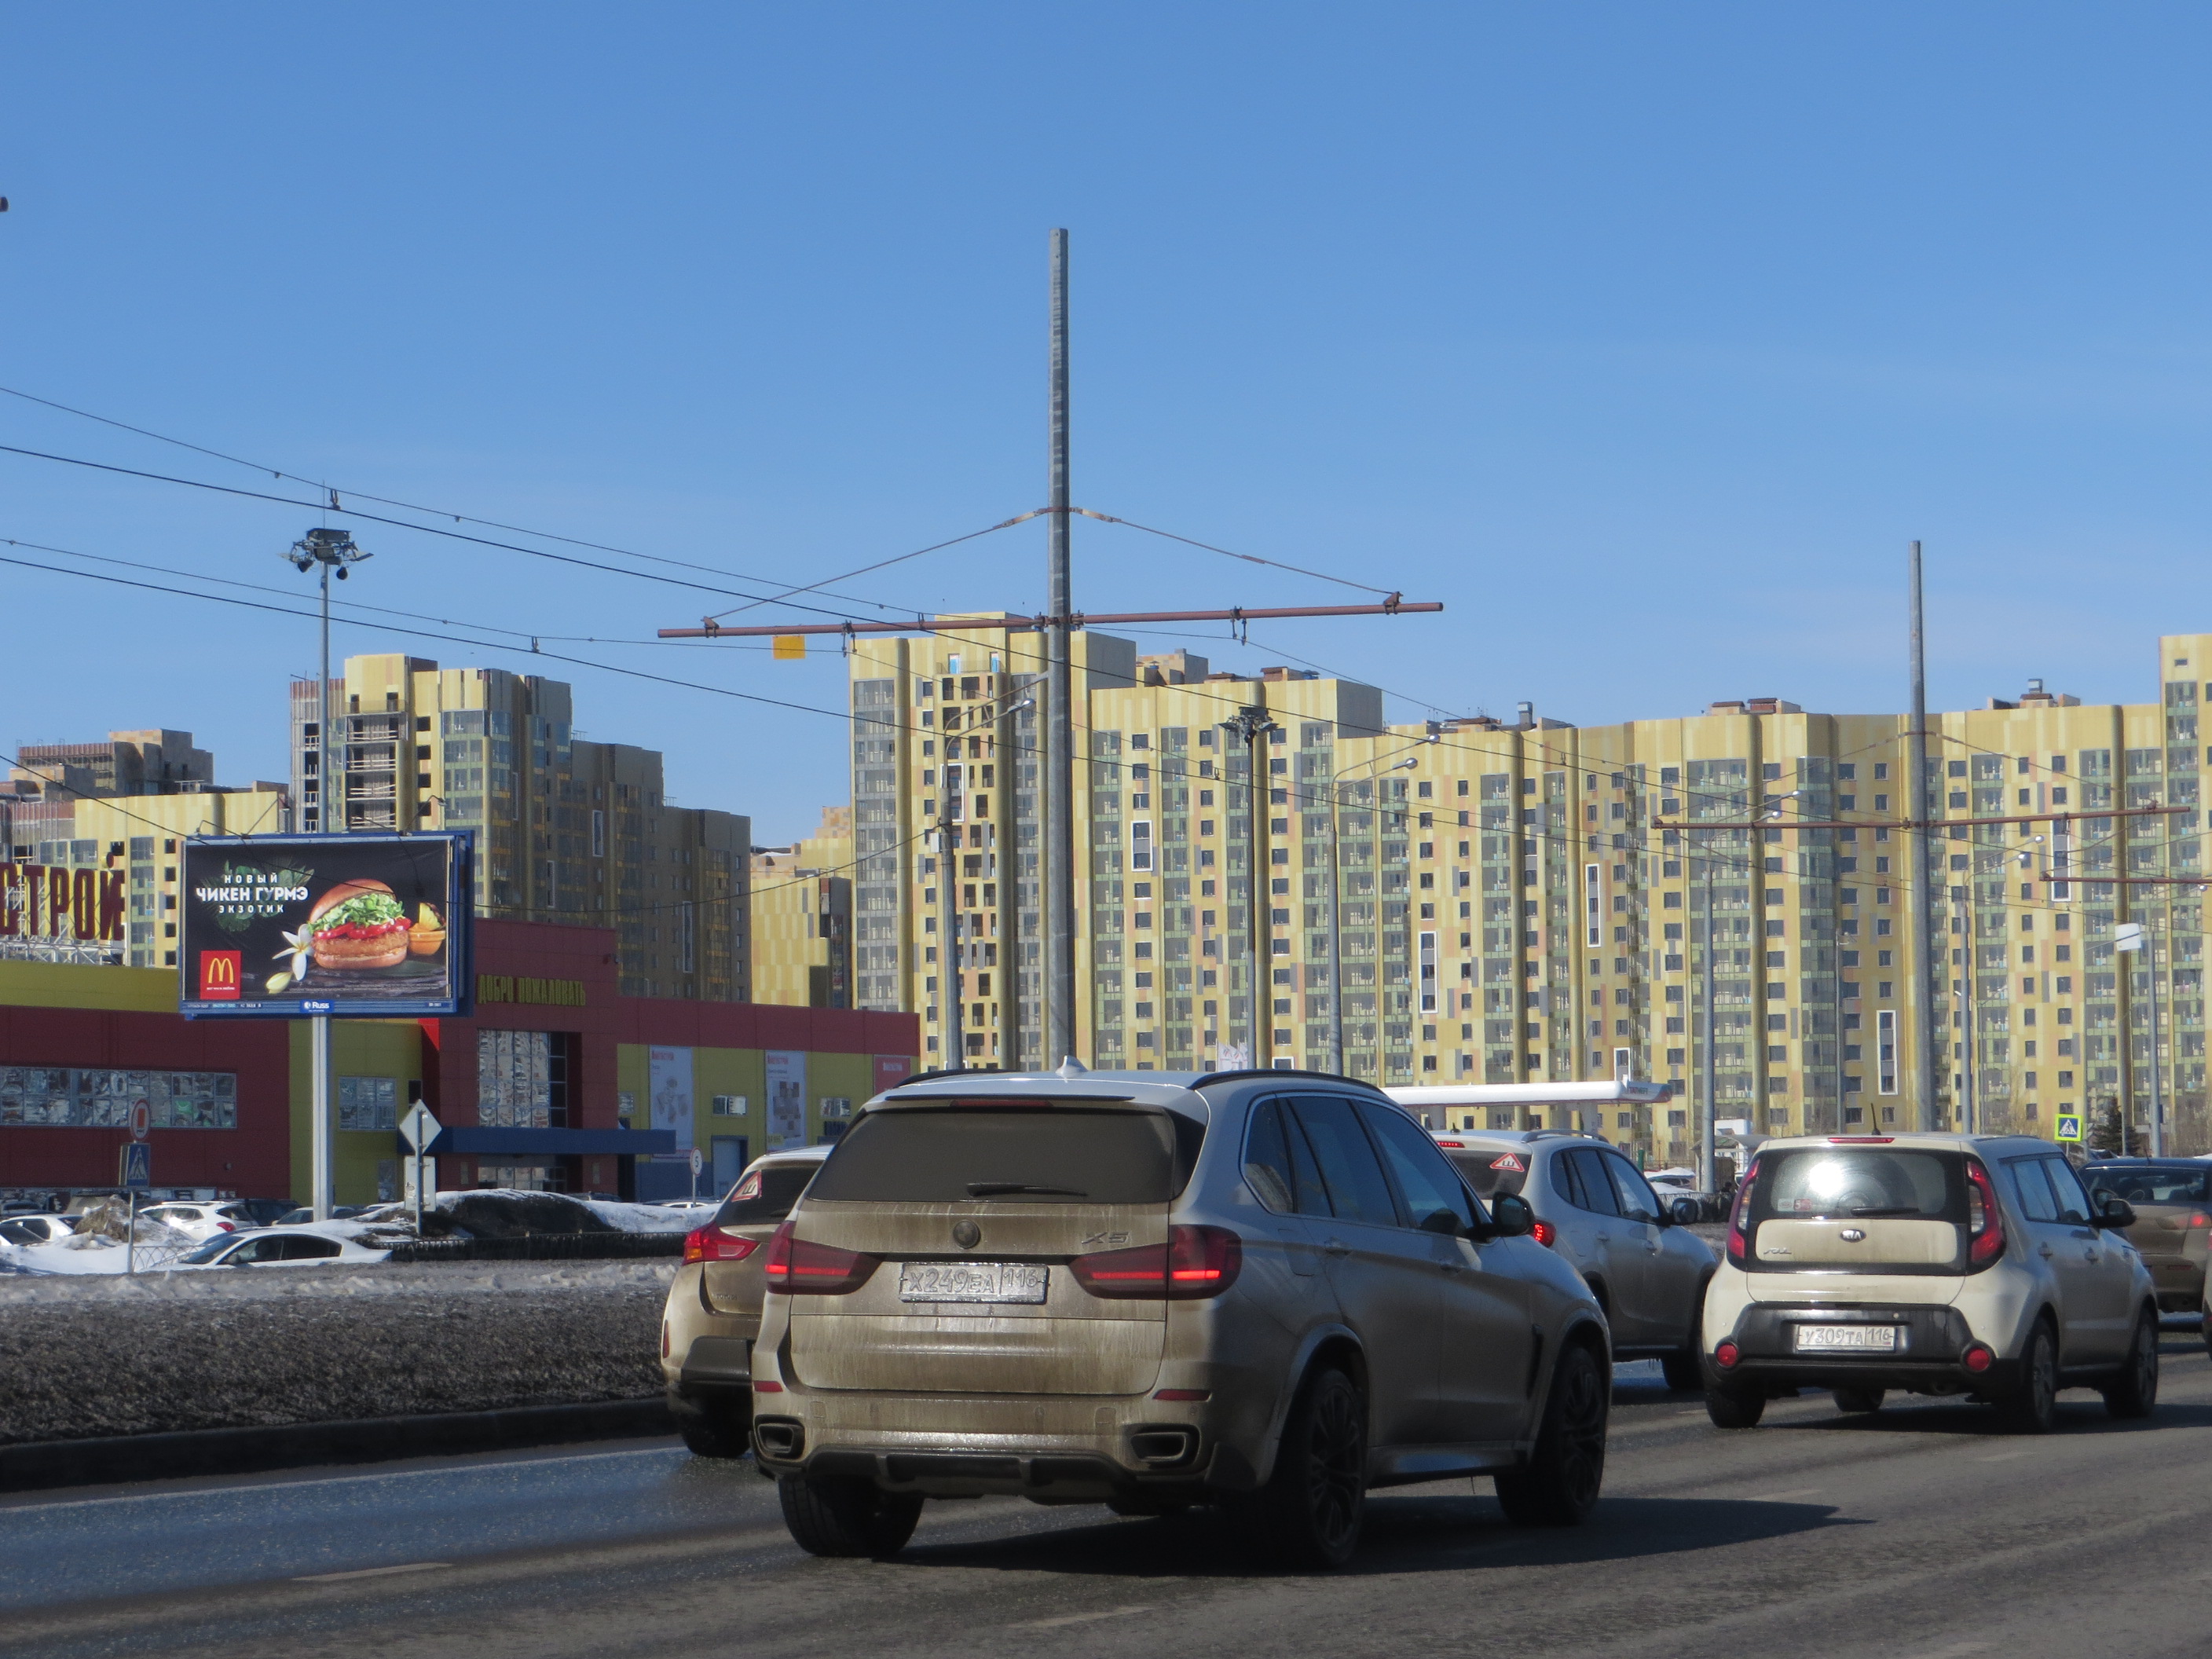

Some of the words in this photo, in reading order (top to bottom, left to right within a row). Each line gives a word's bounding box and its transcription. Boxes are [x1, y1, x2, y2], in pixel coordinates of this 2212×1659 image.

[224, 873, 278, 884] НОВЫЙ
[196, 887, 251, 902] ЧИКЕН
[255, 887, 309, 902] ГУРМЭ
[218, 905, 284, 914] ЭКЗОТИК
[694, 1156, 700, 1168] 5
[742, 1184, 757, 1195] Ш
